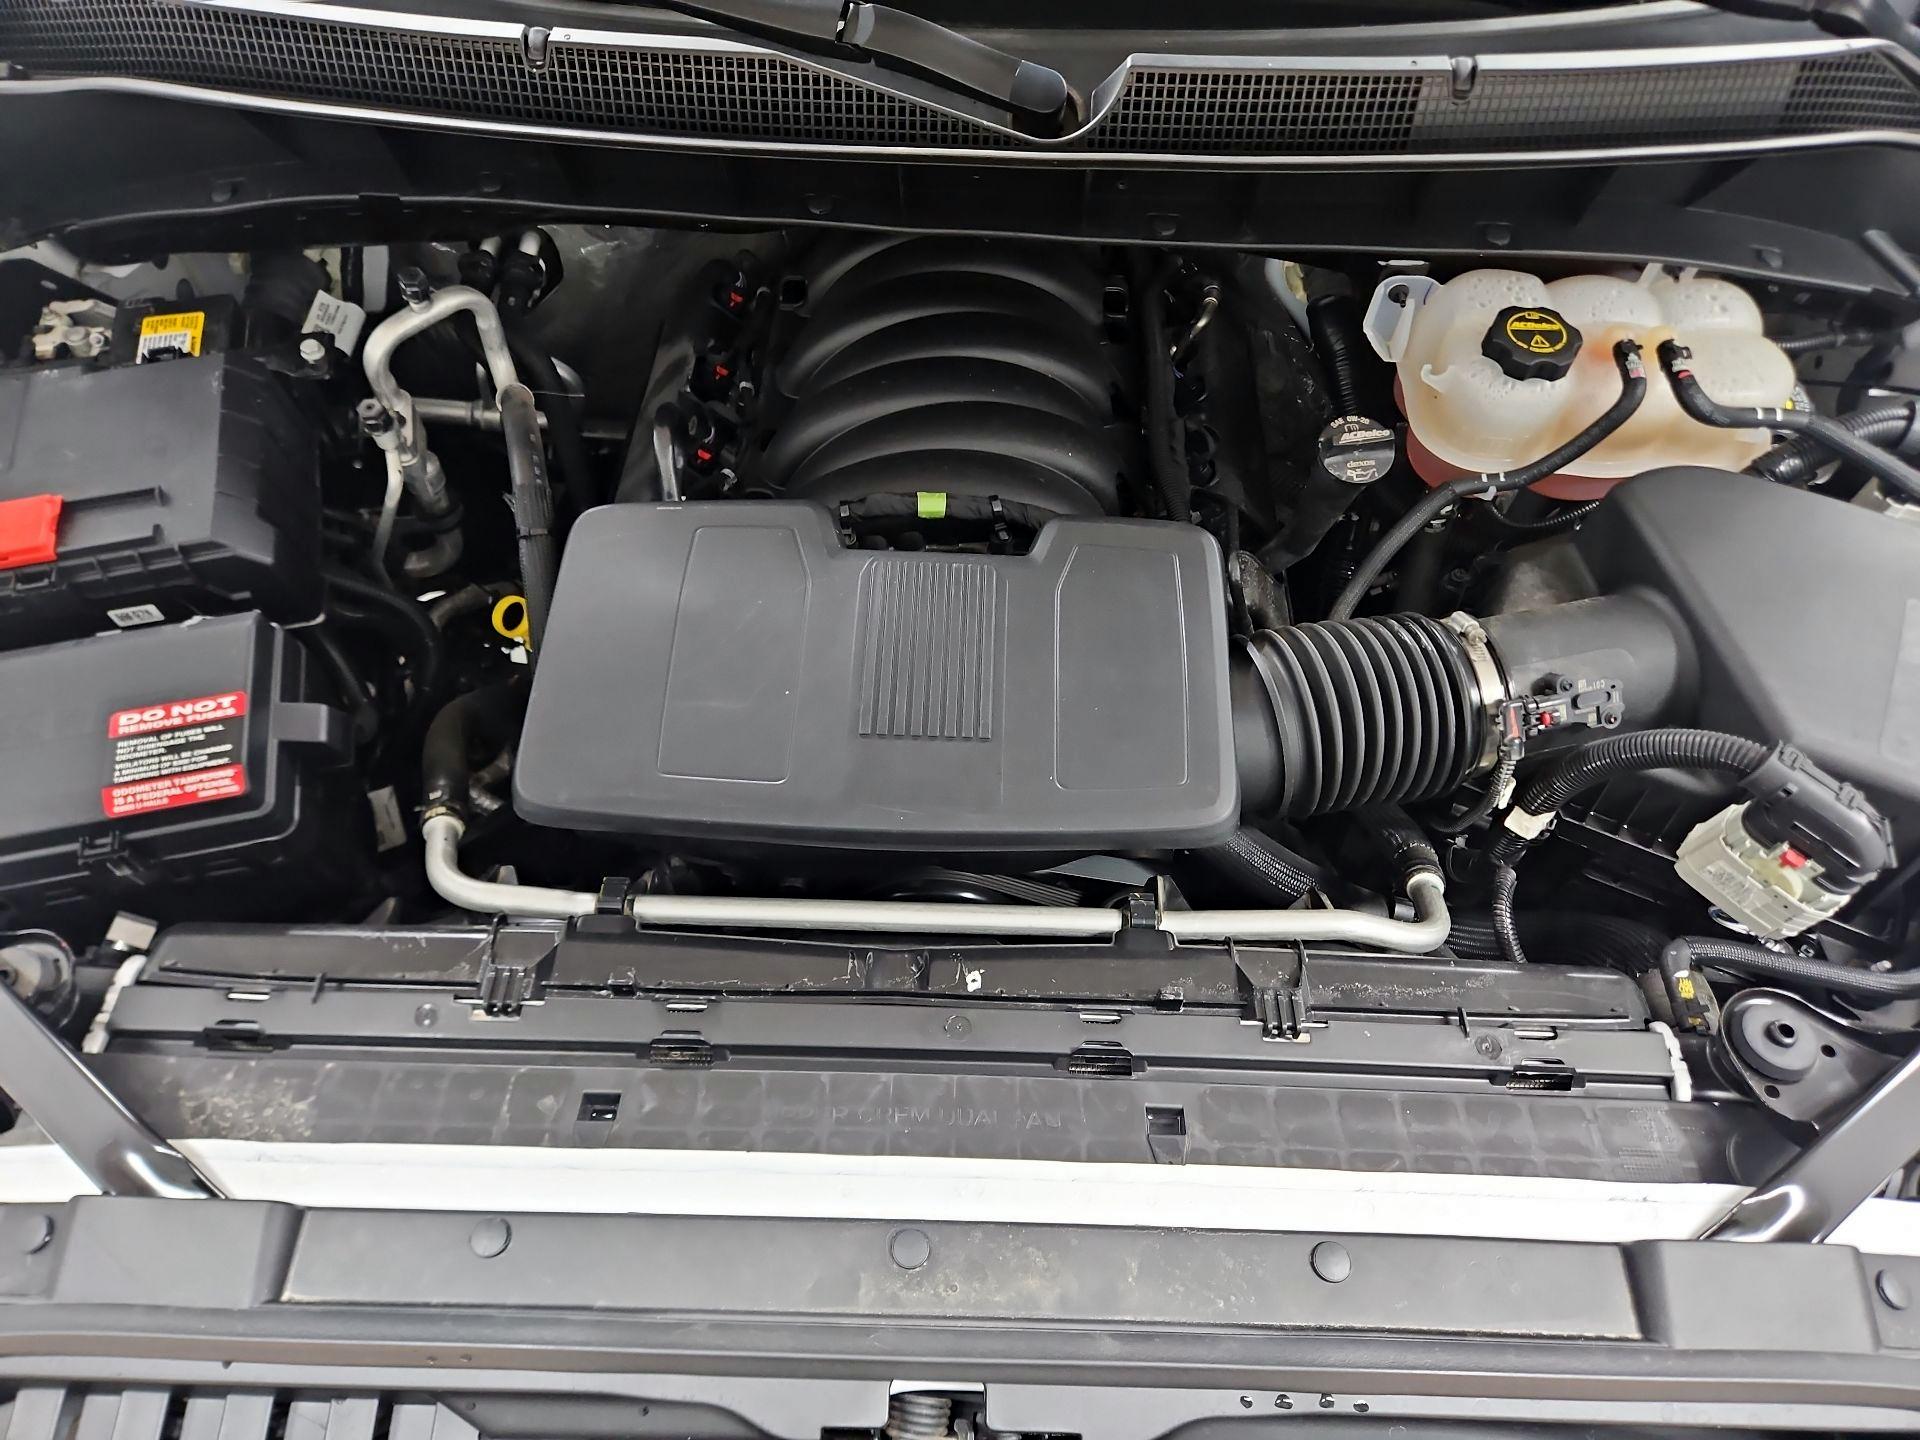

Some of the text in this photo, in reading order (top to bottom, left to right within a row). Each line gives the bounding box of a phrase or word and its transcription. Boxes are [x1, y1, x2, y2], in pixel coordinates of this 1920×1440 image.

[1330, 415, 1370, 428] SAE 0W-20
[1340, 429, 1391, 441] ACDelco
[1346, 460, 1376, 468] dexos
[119, 695, 237, 726] DO NOT
[119, 707, 236, 734] REMOVE FUSES
[116, 747, 134, 755] NOT
[188, 734, 206, 742] THE
[117, 736, 158, 748] REMOVAL
[175, 728, 202, 738] FUSES
[114, 757, 159, 770] VIOLATORS
[161, 754, 179, 762] WILL
[112, 780, 172, 797] ODOMETER
[114, 797, 125, 805] IS
[136, 787, 183, 801] FEDERAL
